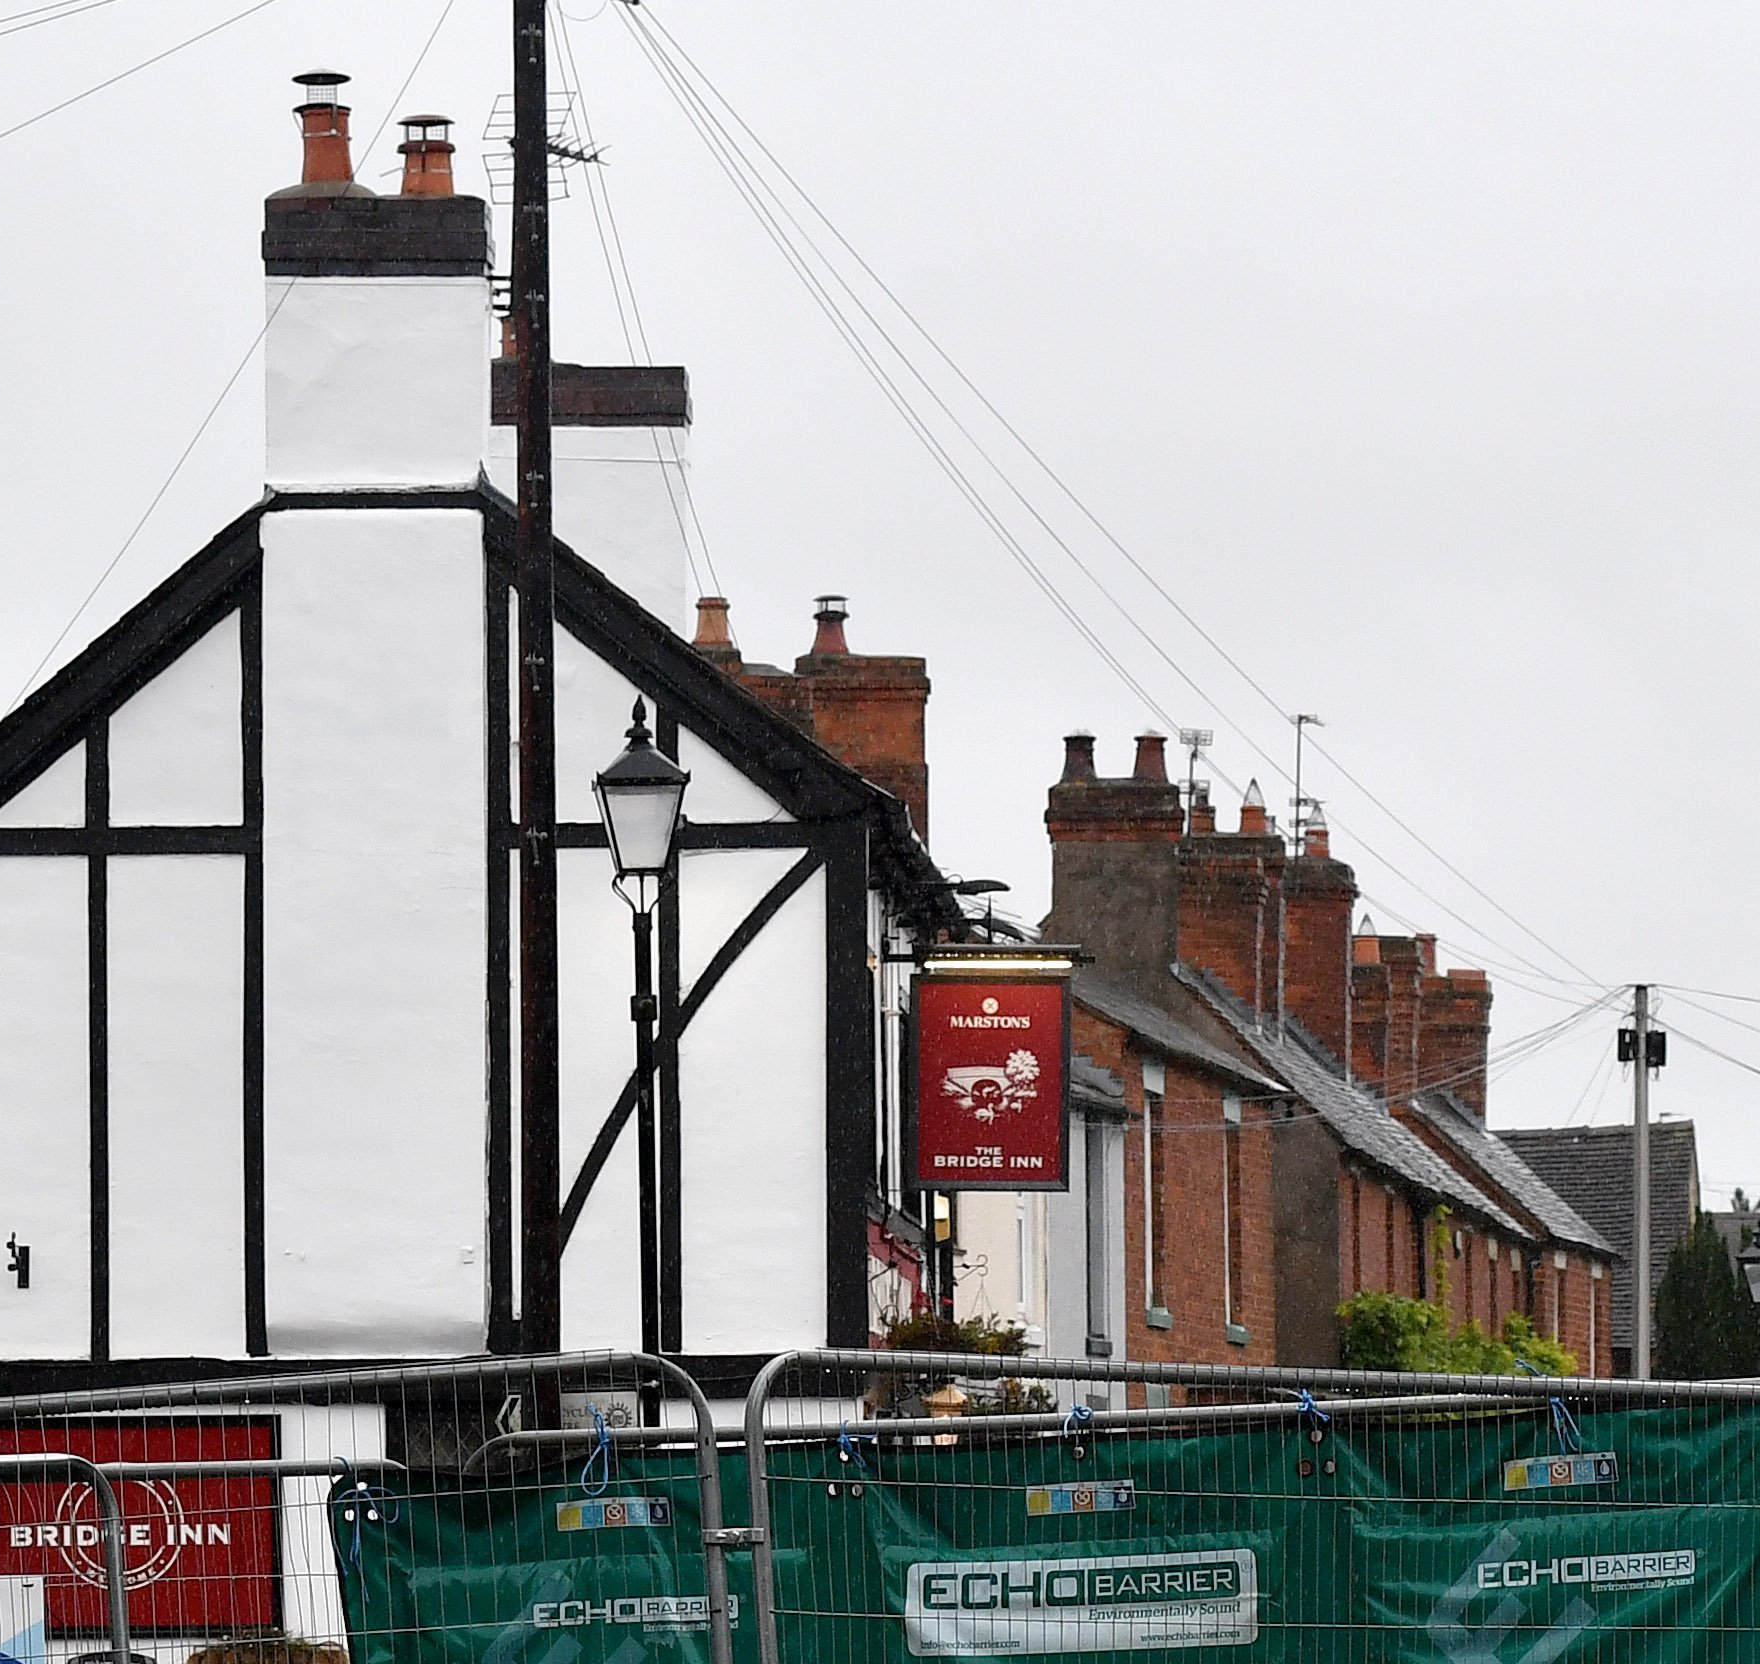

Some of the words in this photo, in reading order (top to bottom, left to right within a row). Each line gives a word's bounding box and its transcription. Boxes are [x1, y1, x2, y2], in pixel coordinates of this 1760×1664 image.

[934, 1156, 1004, 1168] BRIDGE
[1010, 1156, 1043, 1168] INN
[975, 1147, 1002, 1156] THE
[167, 1522, 231, 1546] INN
[1477, 1557, 1590, 1588] ECHO
[1594, 1553, 1691, 1577] BARRIER
[923, 1569, 1086, 1610] ECHO
[1095, 1567, 1234, 1597] BARRIER
[533, 1598, 641, 1628] ECHO
[1088, 1604, 1197, 1621] Environmentally
[1199, 1602, 1241, 1616] Sound
